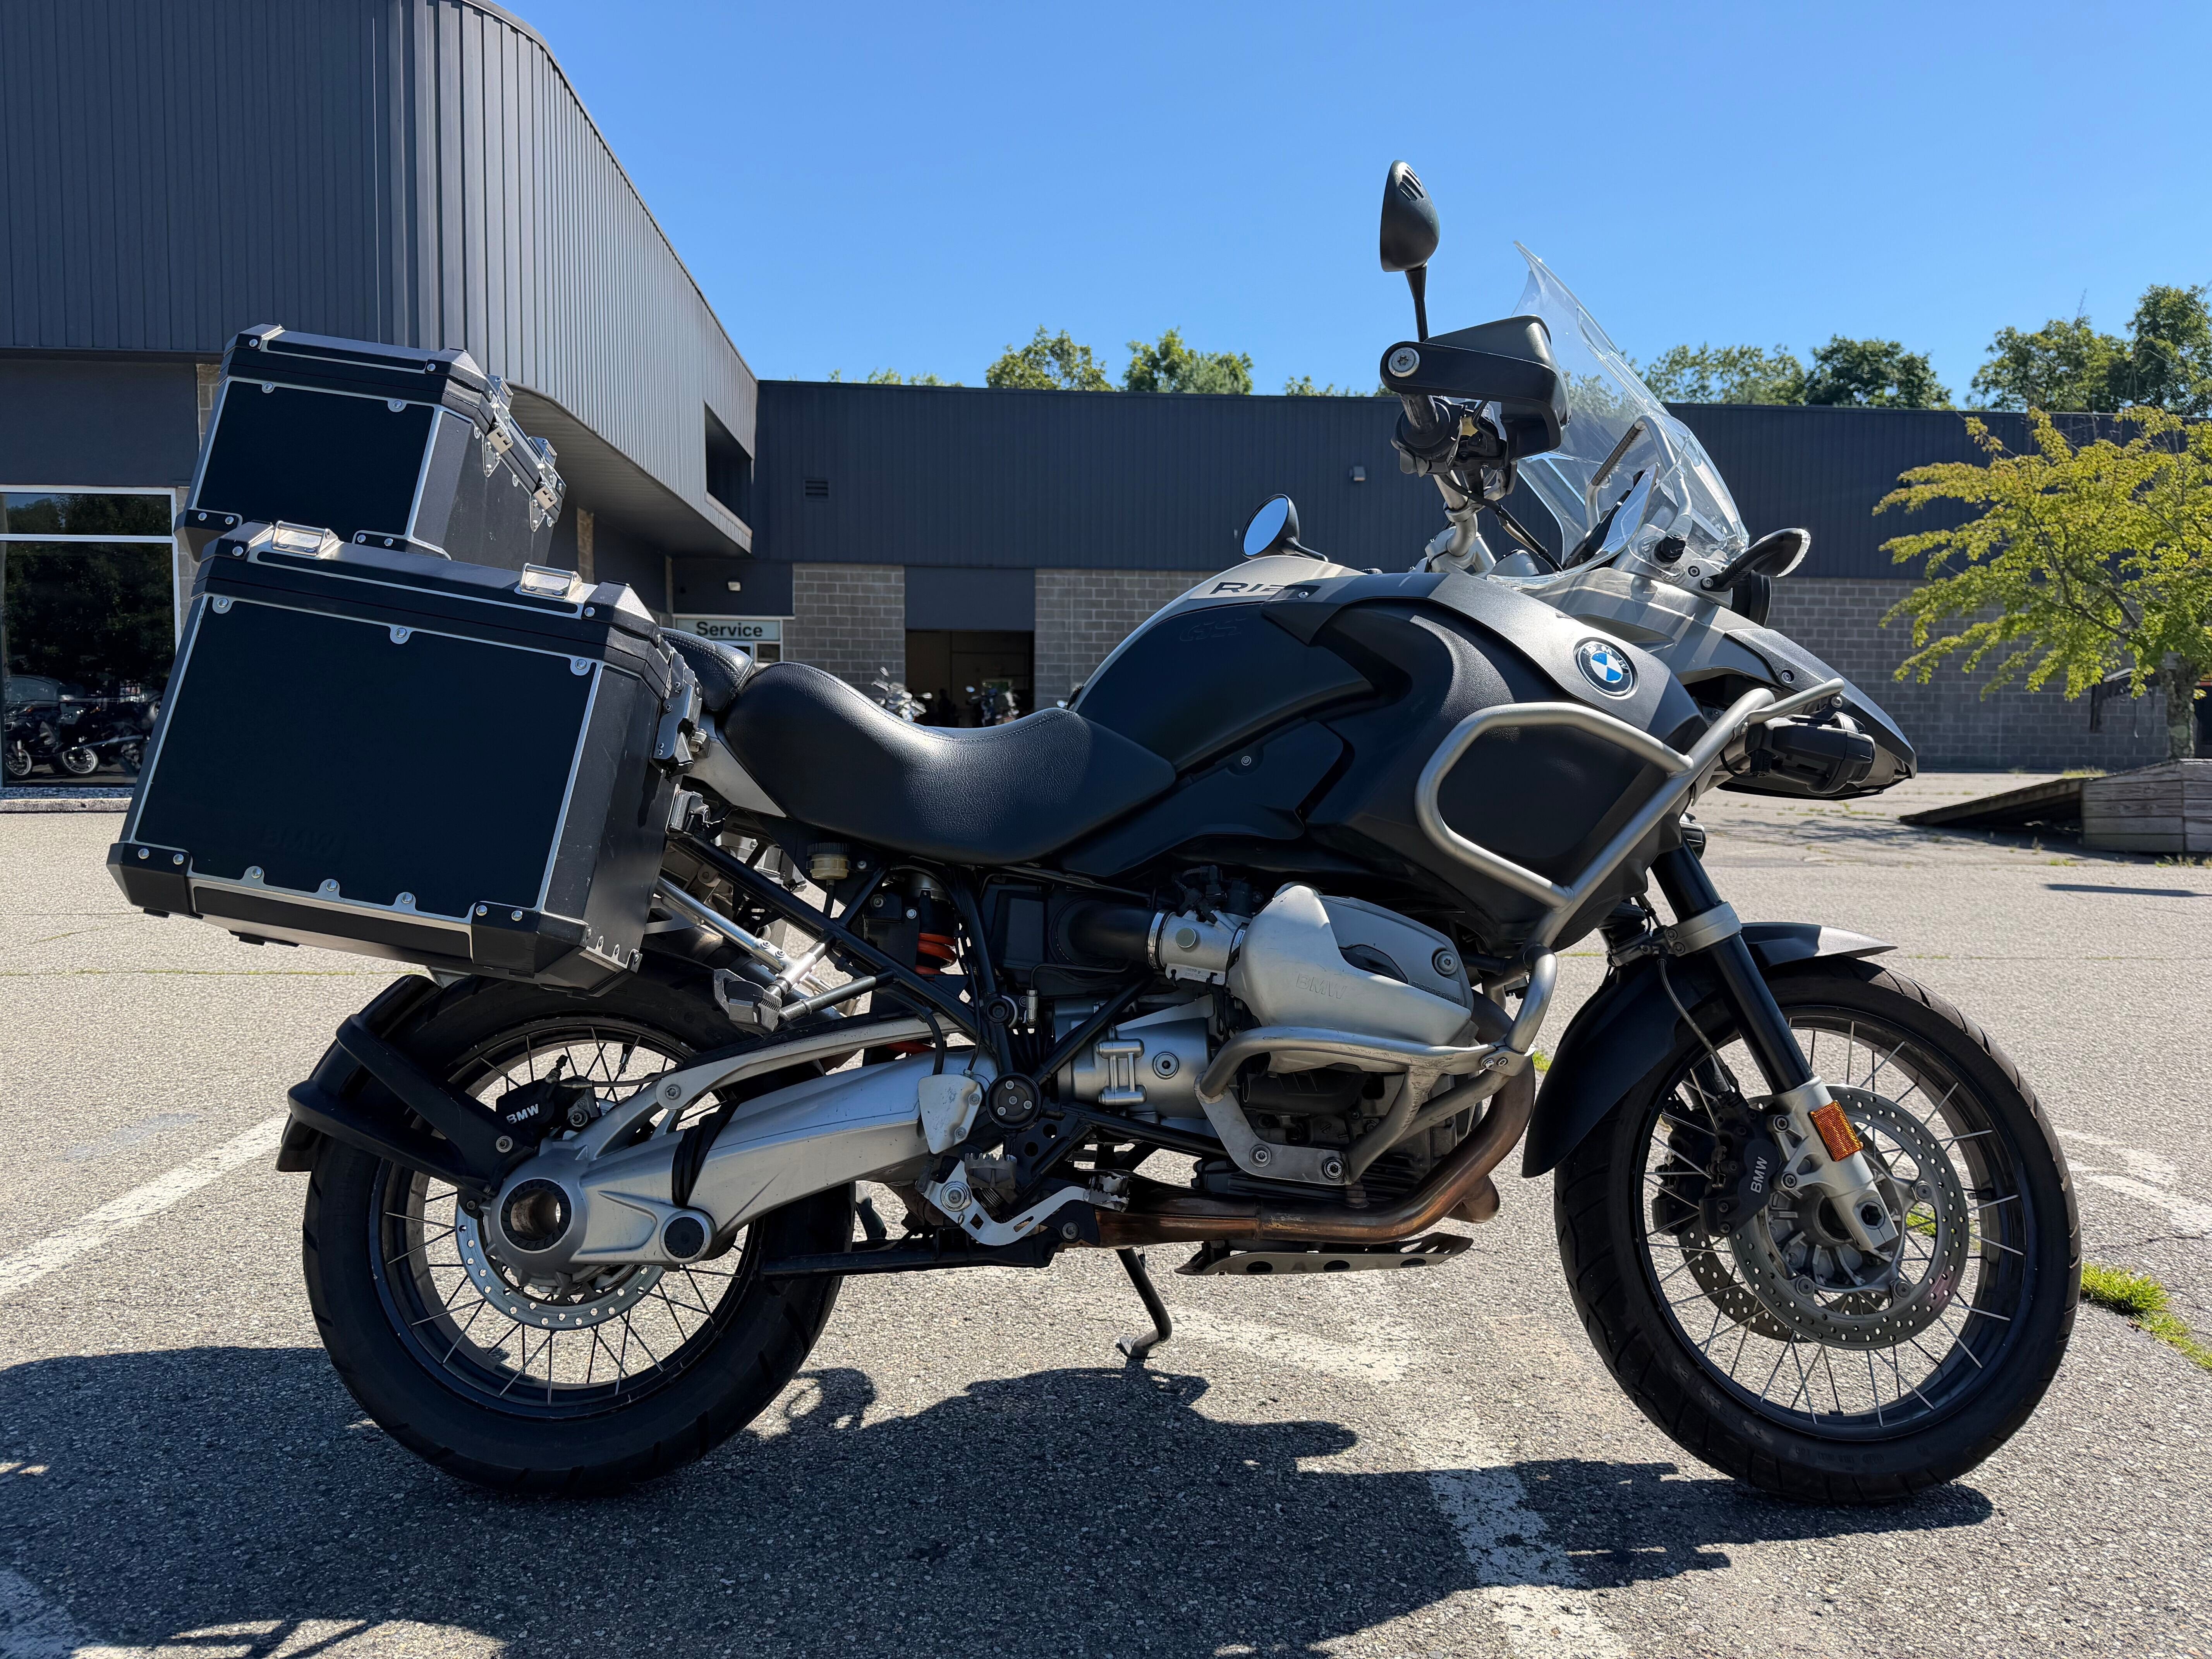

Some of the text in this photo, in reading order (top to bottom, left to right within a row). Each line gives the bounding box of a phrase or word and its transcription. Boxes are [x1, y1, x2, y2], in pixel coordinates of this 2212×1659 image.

[696, 621, 763, 637] Service
[1583, 644, 1629, 672] BMW
[1295, 973, 1348, 999] BMW
[506, 1103, 539, 1125] BMW
[1750, 1156, 1768, 1194] BMW
